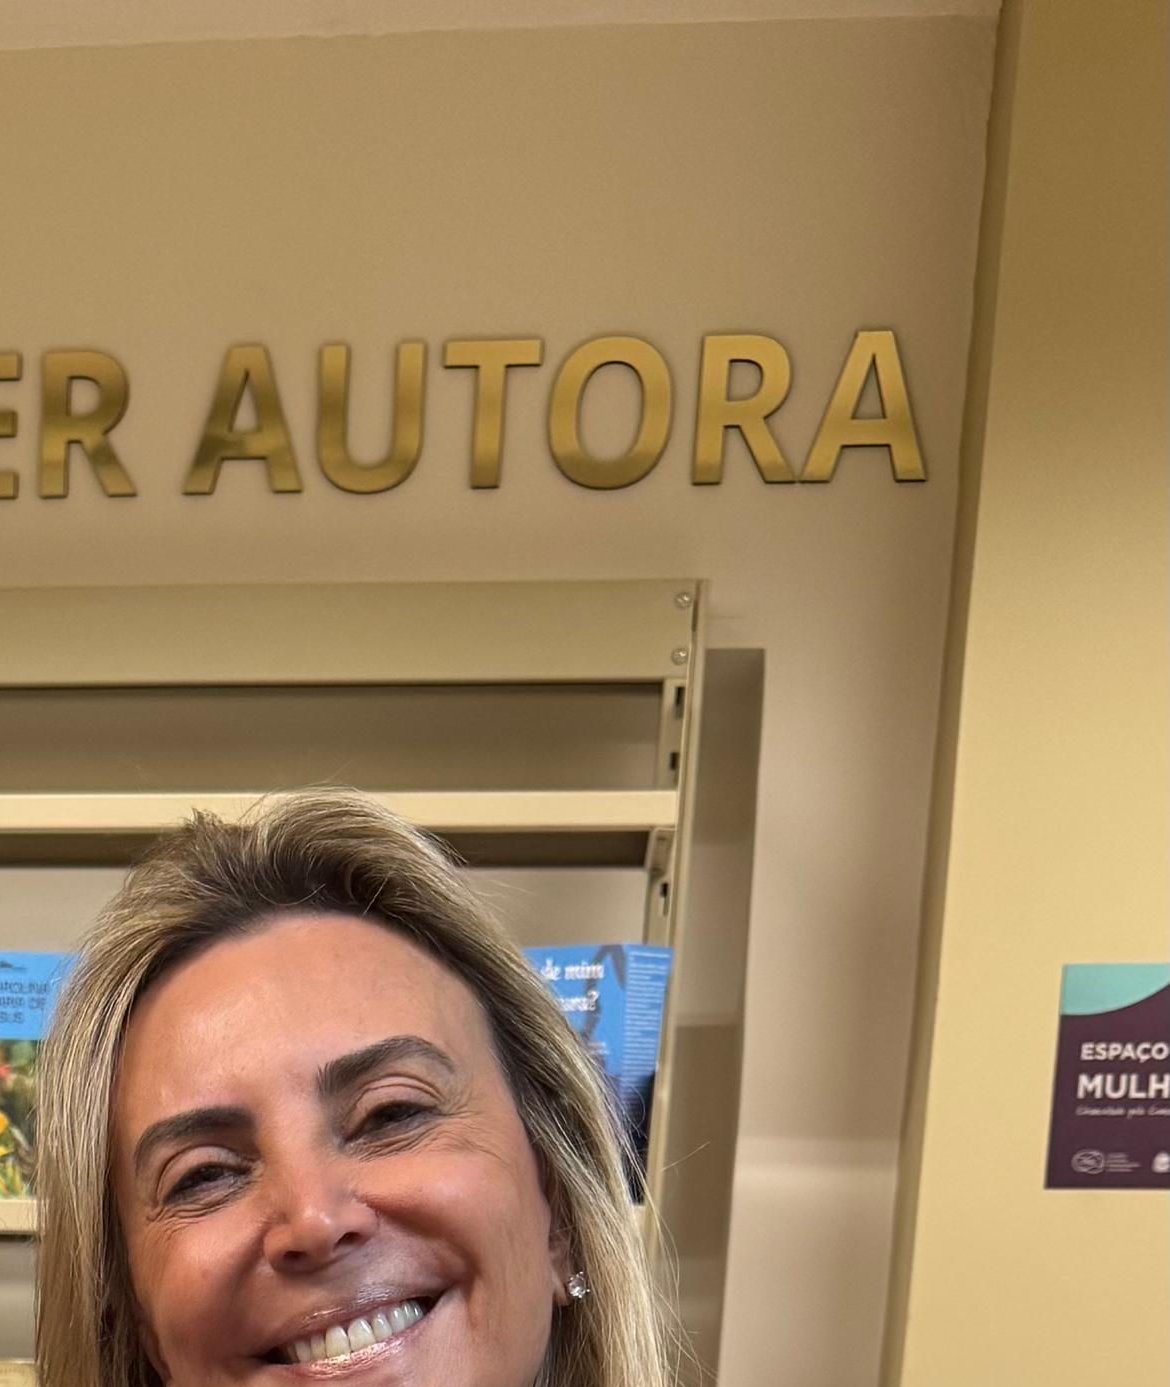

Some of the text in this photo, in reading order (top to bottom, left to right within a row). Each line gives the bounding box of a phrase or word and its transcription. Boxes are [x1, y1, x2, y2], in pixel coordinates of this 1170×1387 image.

[183, 330, 928, 497] AUTORA
[1080, 1041, 1169, 1063] ESPAÇO
[1076, 1073, 1170, 1100] MULH
